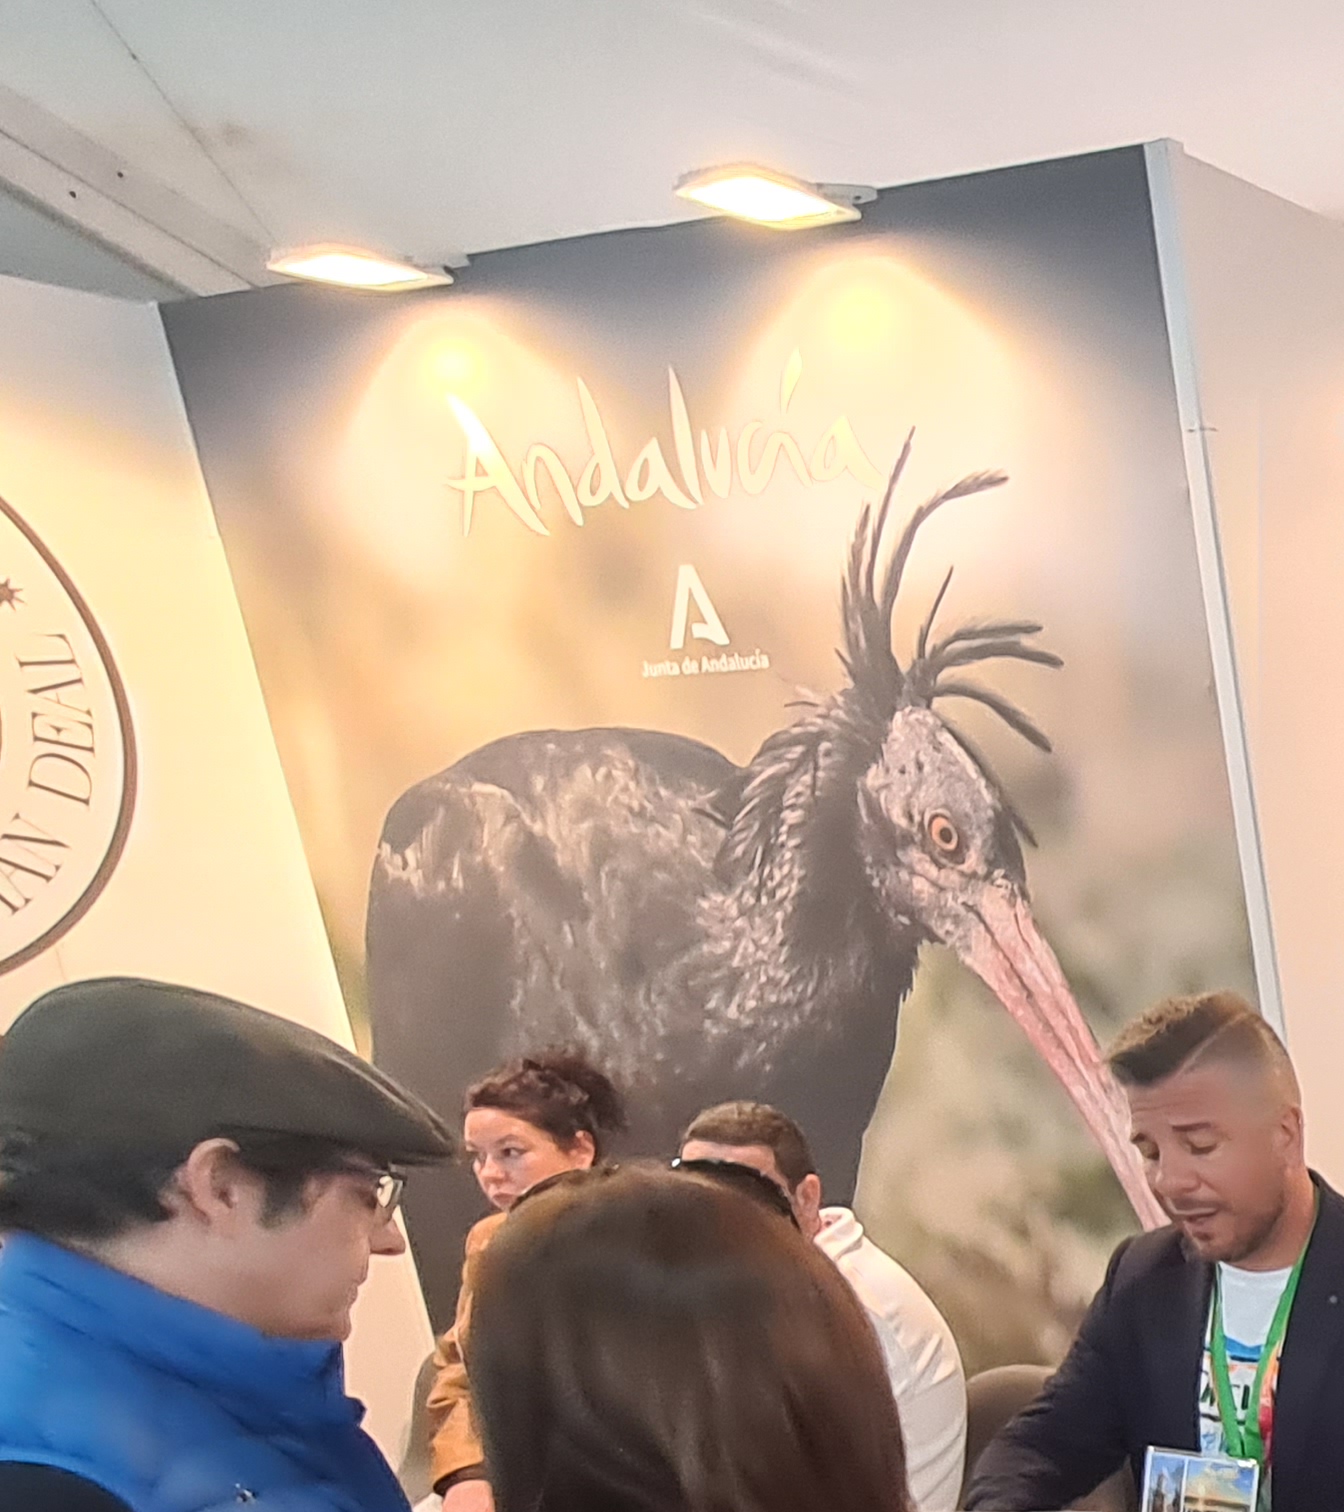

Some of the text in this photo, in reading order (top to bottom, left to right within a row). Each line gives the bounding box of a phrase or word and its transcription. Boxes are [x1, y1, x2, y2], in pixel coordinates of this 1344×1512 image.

[443, 348, 884, 536] Andalucía
[15, 632, 96, 810] DEAL
[642, 648, 770, 678] Junta de Andalucía
